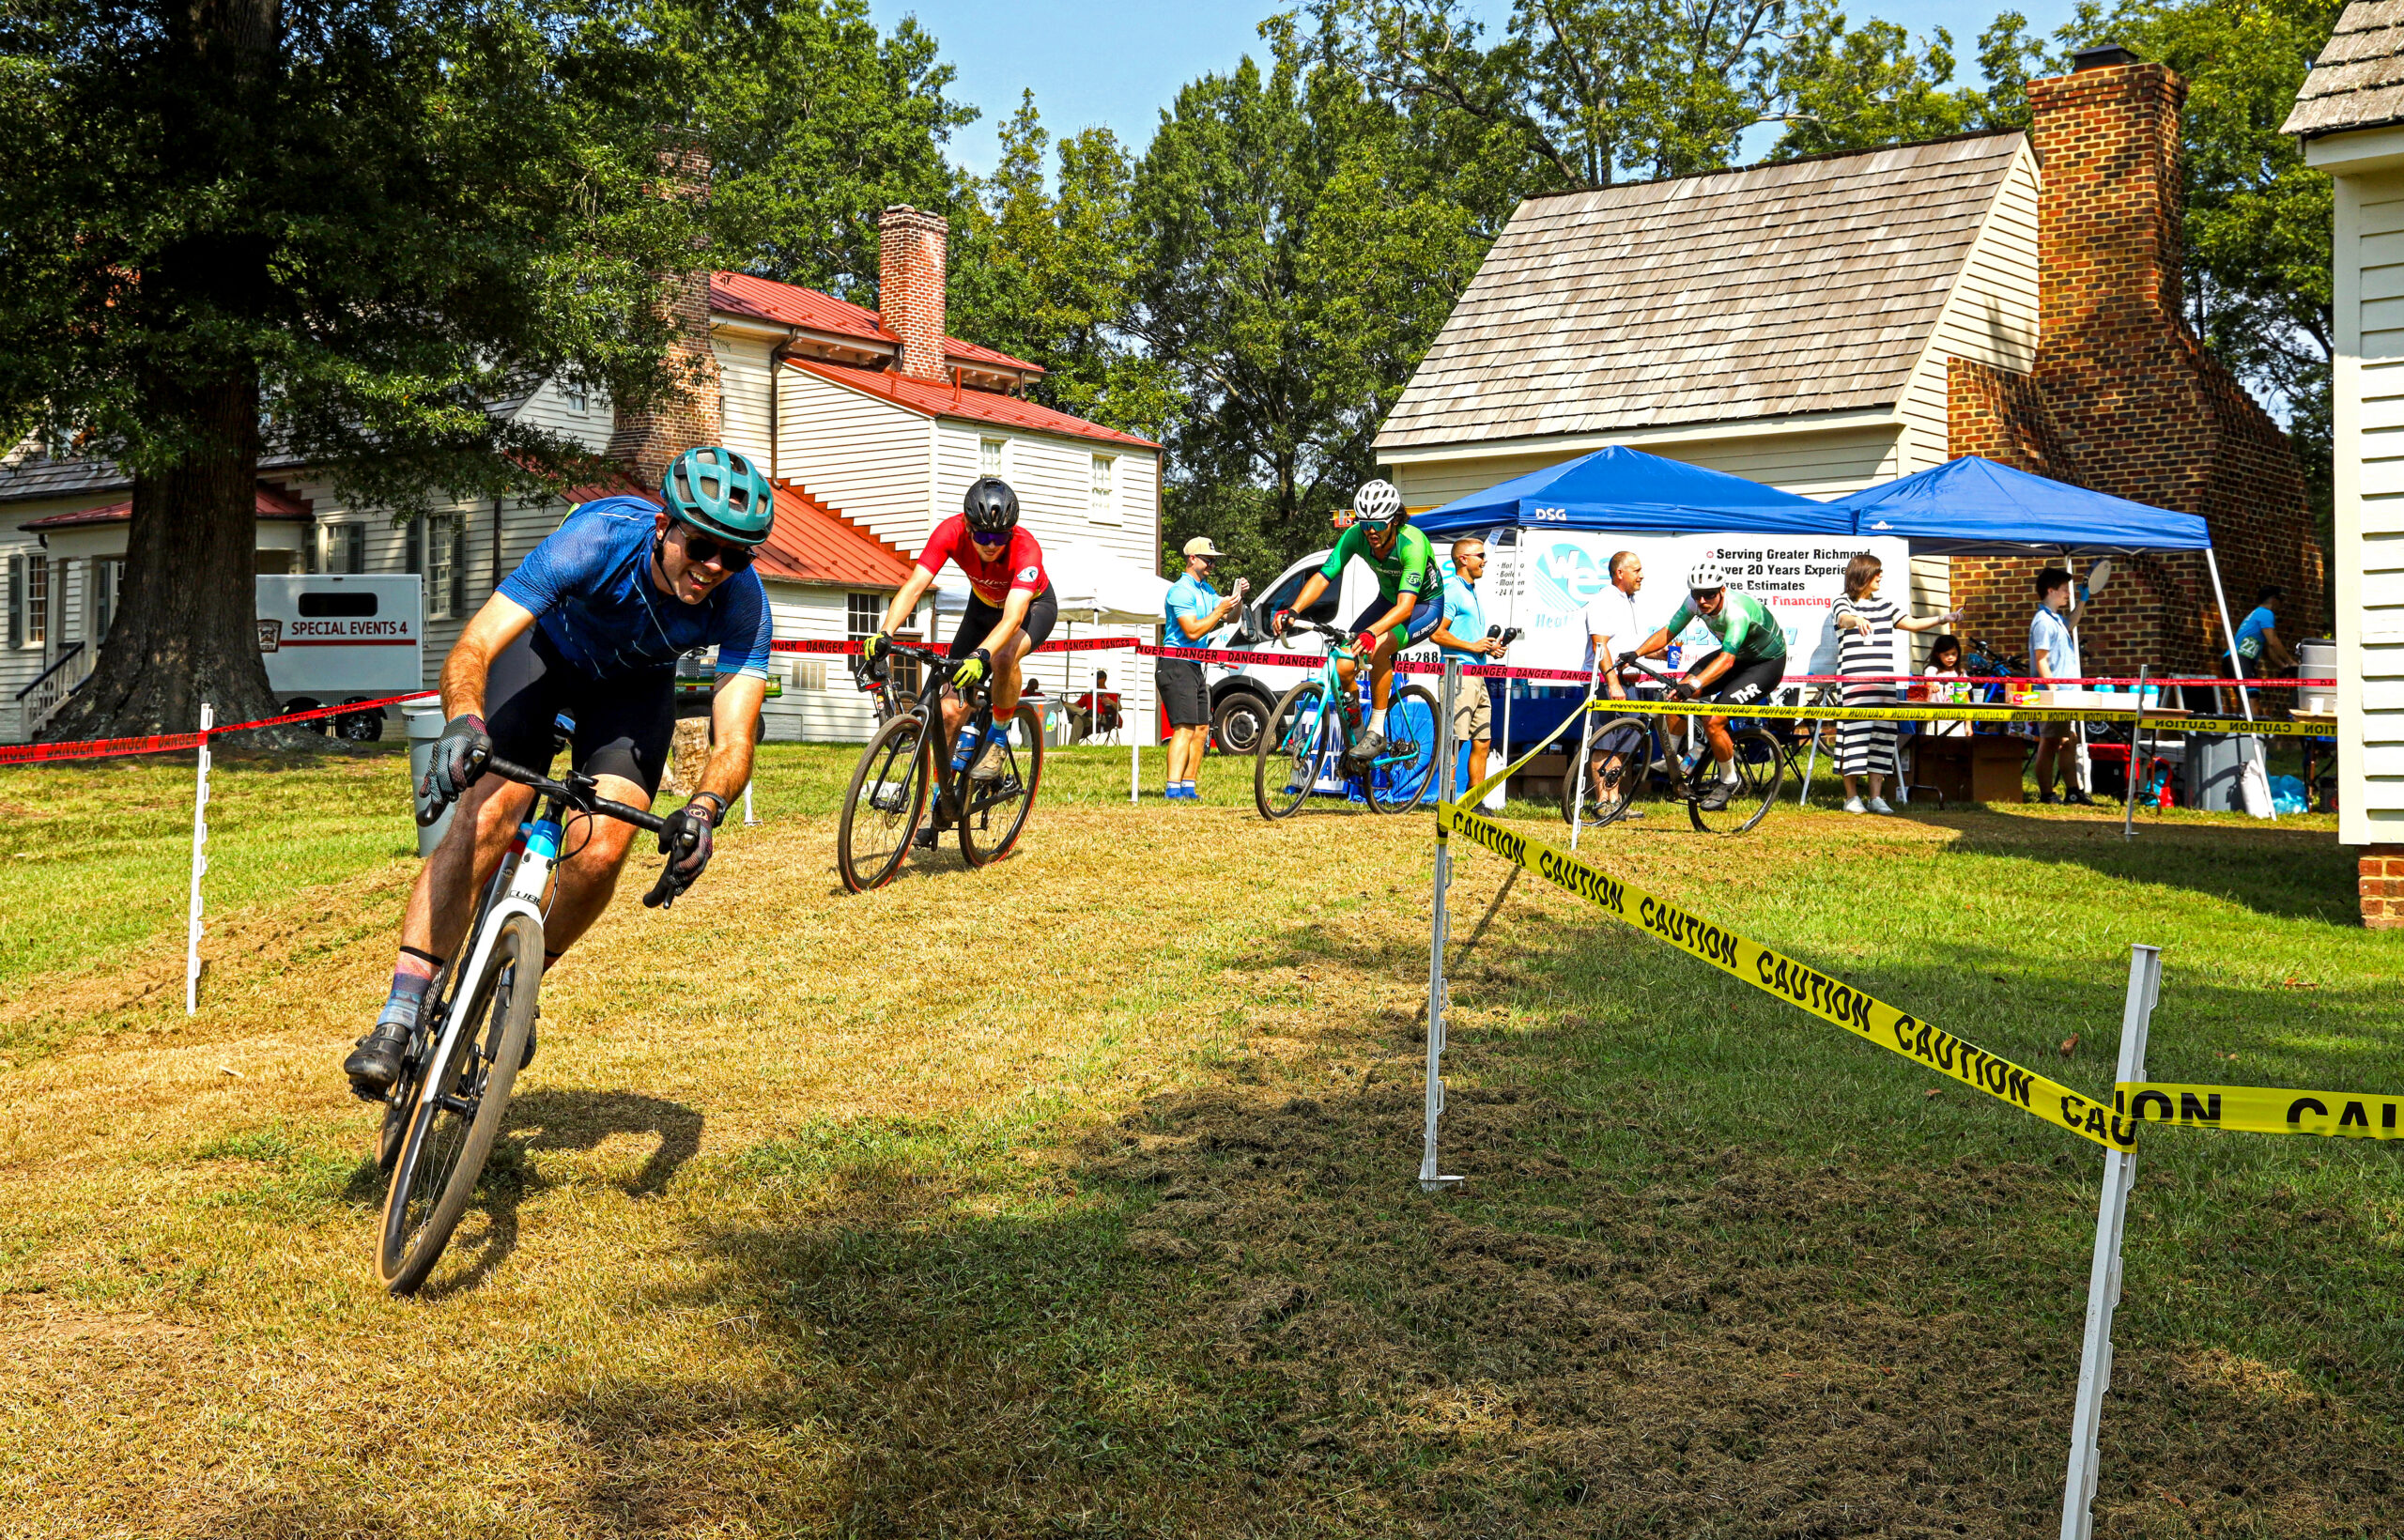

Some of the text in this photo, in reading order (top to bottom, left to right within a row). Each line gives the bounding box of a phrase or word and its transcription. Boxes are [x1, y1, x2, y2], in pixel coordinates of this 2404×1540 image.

[1535, 509, 1566, 521] DSG
[1717, 549, 1763, 562] Serving
[1767, 549, 1809, 560] Greater
[1724, 566, 1744, 576] ver
[1748, 565, 1764, 576] 20
[1768, 565, 1800, 576] Years
[1725, 580, 1805, 591] ree Estimates
[1773, 596, 1831, 608] Financing
[291, 622, 347, 635] SPECIAL
[350, 622, 396, 635] EVENTS
[399, 622, 408, 634] 4
[806, 641, 845, 653] DANGER
[1063, 640, 1094, 651] DANGER
[1176, 648, 1218, 661] DANGER
[1228, 652, 1269, 664] DANGER
[1279, 655, 1319, 668] DANGER
[1471, 667, 1508, 677] DANGER
[1516, 670, 1553, 679] DANGER
[1560, 671, 1593, 681] DANGE
[1730, 683, 1762, 704] THR
[1453, 811, 1526, 867] CAUTION
[1539, 850, 1624, 915] CAUTION
[1641, 896, 1738, 968] CAUTION
[1756, 950, 1872, 1033] CAUTION
[1893, 1013, 2035, 1107] CAUTION
